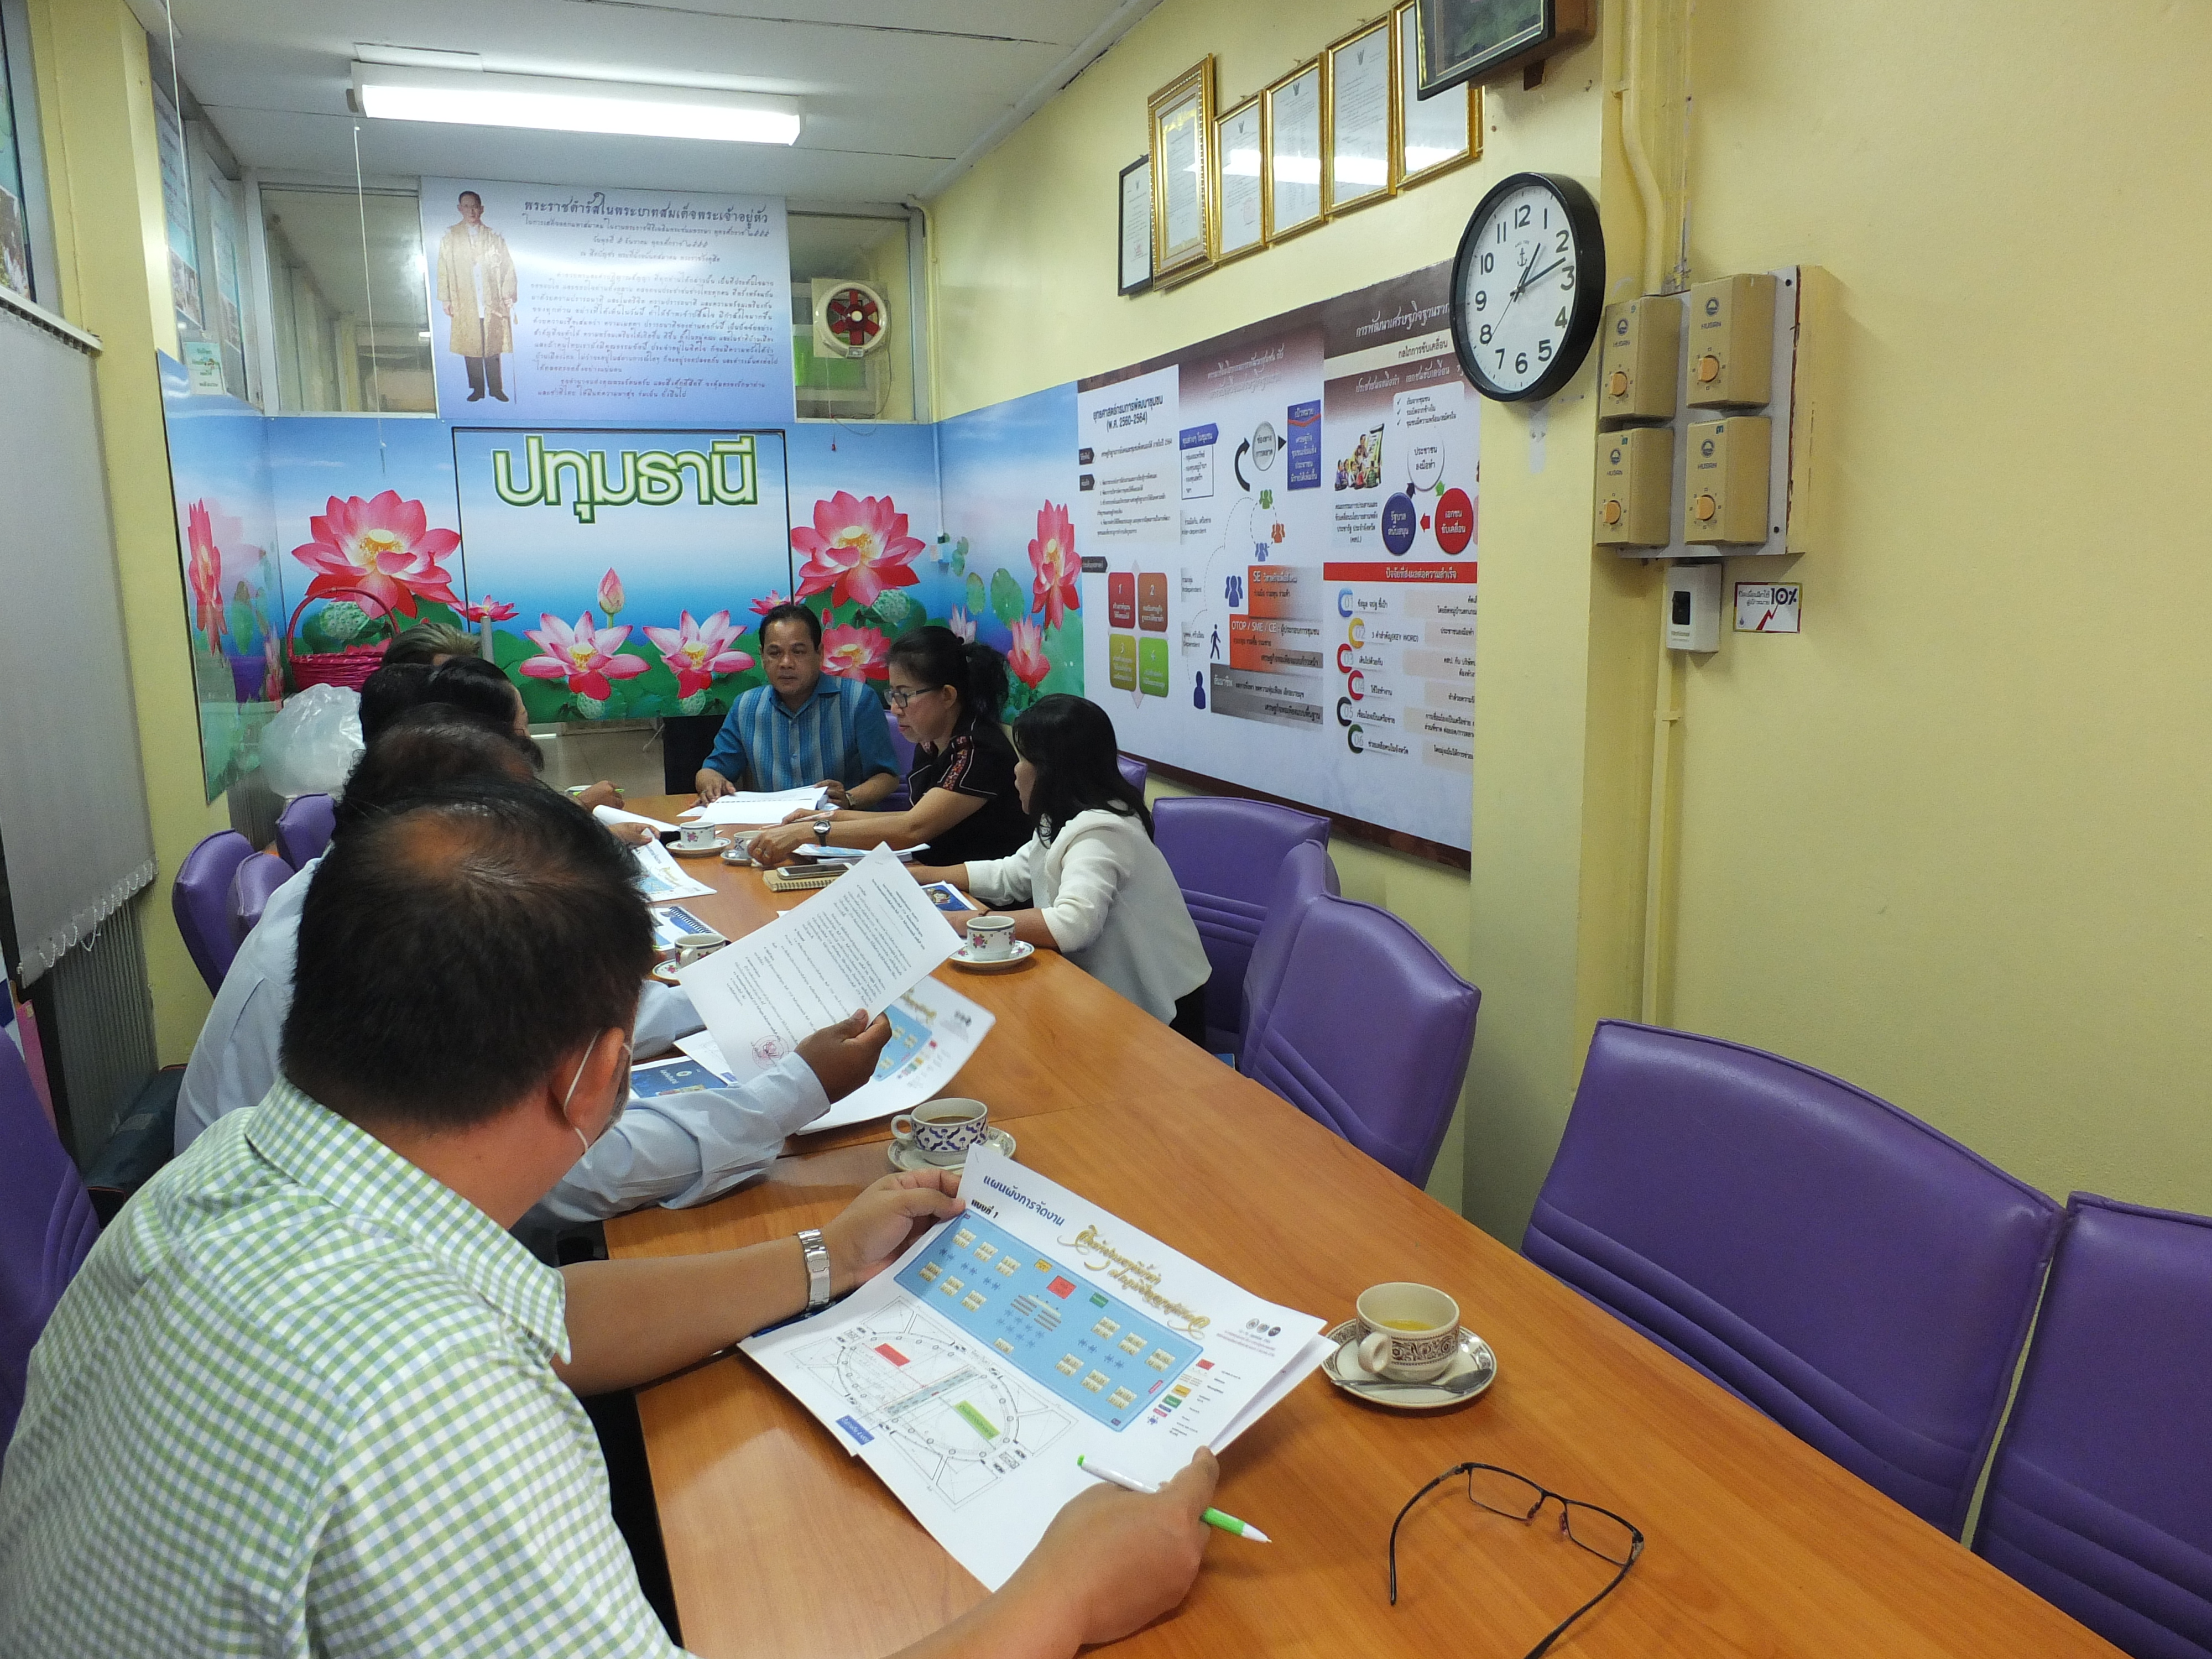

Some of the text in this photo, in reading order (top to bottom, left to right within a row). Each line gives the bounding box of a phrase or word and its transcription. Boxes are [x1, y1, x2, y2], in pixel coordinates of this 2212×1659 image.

[1515, 205, 1530, 229] 12
[1544, 208, 1547, 229] 1
[1497, 222, 1506, 244] 11
[1555, 229, 1569, 253] 2
[1480, 253, 1494, 275] 10
[1561, 265, 1574, 290] 3
[1475, 291, 1486, 311] 9
[1554, 306, 1568, 328] 4
[1480, 325, 1492, 345] 8
[1495, 348, 1505, 369] 7
[1538, 339, 1552, 362] 5
[1515, 352, 1527, 374] 6
[492, 434, 758, 524] ปทุมธานี
[1770, 587, 1798, 606] 10%
[1232, 620, 1247, 632] OTOP
[971, 1198, 992, 1215] แบบที่
[983, 1174, 1065, 1227] แผนผังการจัดงาน
